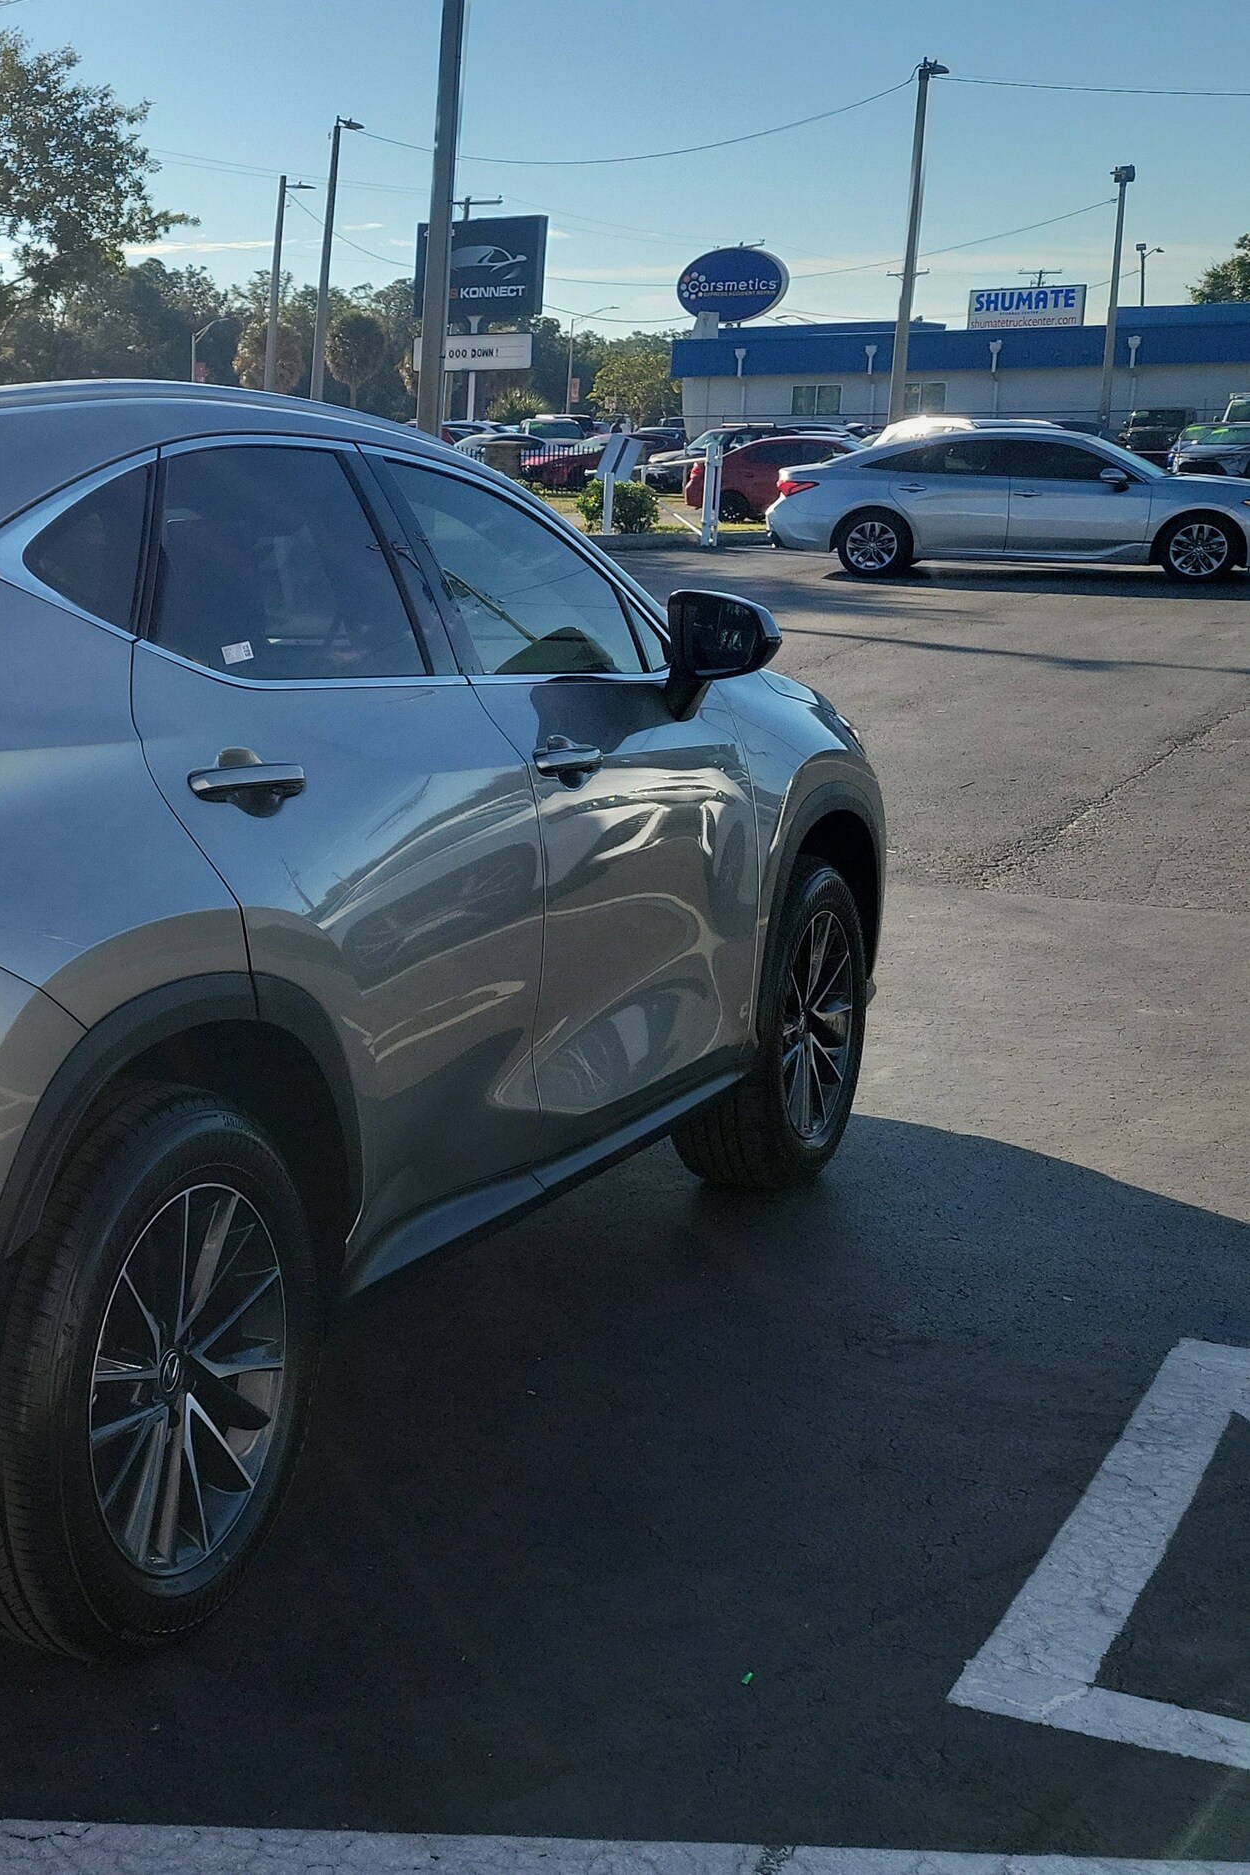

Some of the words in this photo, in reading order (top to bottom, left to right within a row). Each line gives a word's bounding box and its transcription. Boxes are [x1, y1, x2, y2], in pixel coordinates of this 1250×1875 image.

[460, 285, 525, 299] KONNECT
[688, 278, 777, 293] Carsmetics
[974, 288, 1076, 312] SHUMATE
[970, 316, 1077, 329] shumatetruckcenter.com
